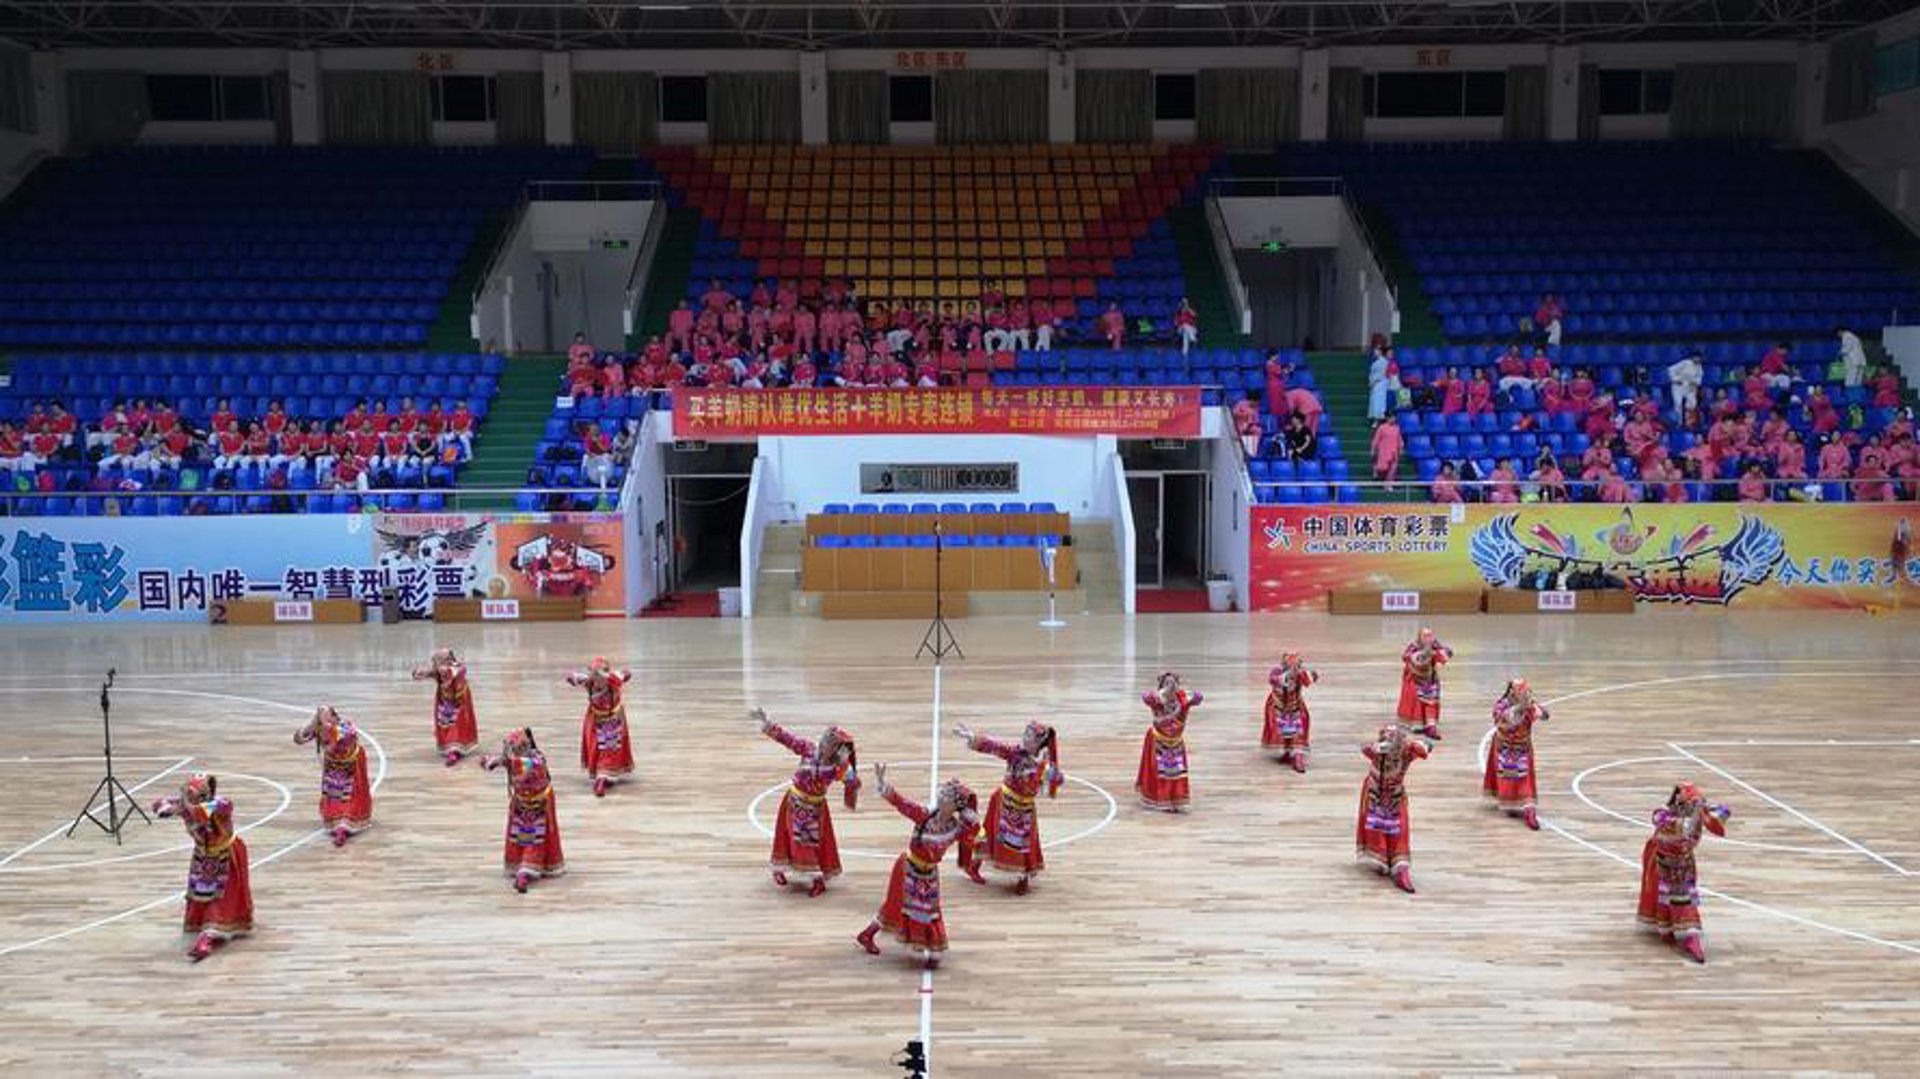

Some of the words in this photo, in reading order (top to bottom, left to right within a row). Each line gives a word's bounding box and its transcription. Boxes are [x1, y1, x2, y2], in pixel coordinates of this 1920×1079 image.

[1303, 515, 1448, 537] 中国体育彩票
[1303, 540, 1338, 552] CHINA
[1345, 540, 1392, 552] SPORTS
[1398, 540, 1448, 552] LOTTERY
[137, 567, 466, 611] 国内唯一智慧型彩票
